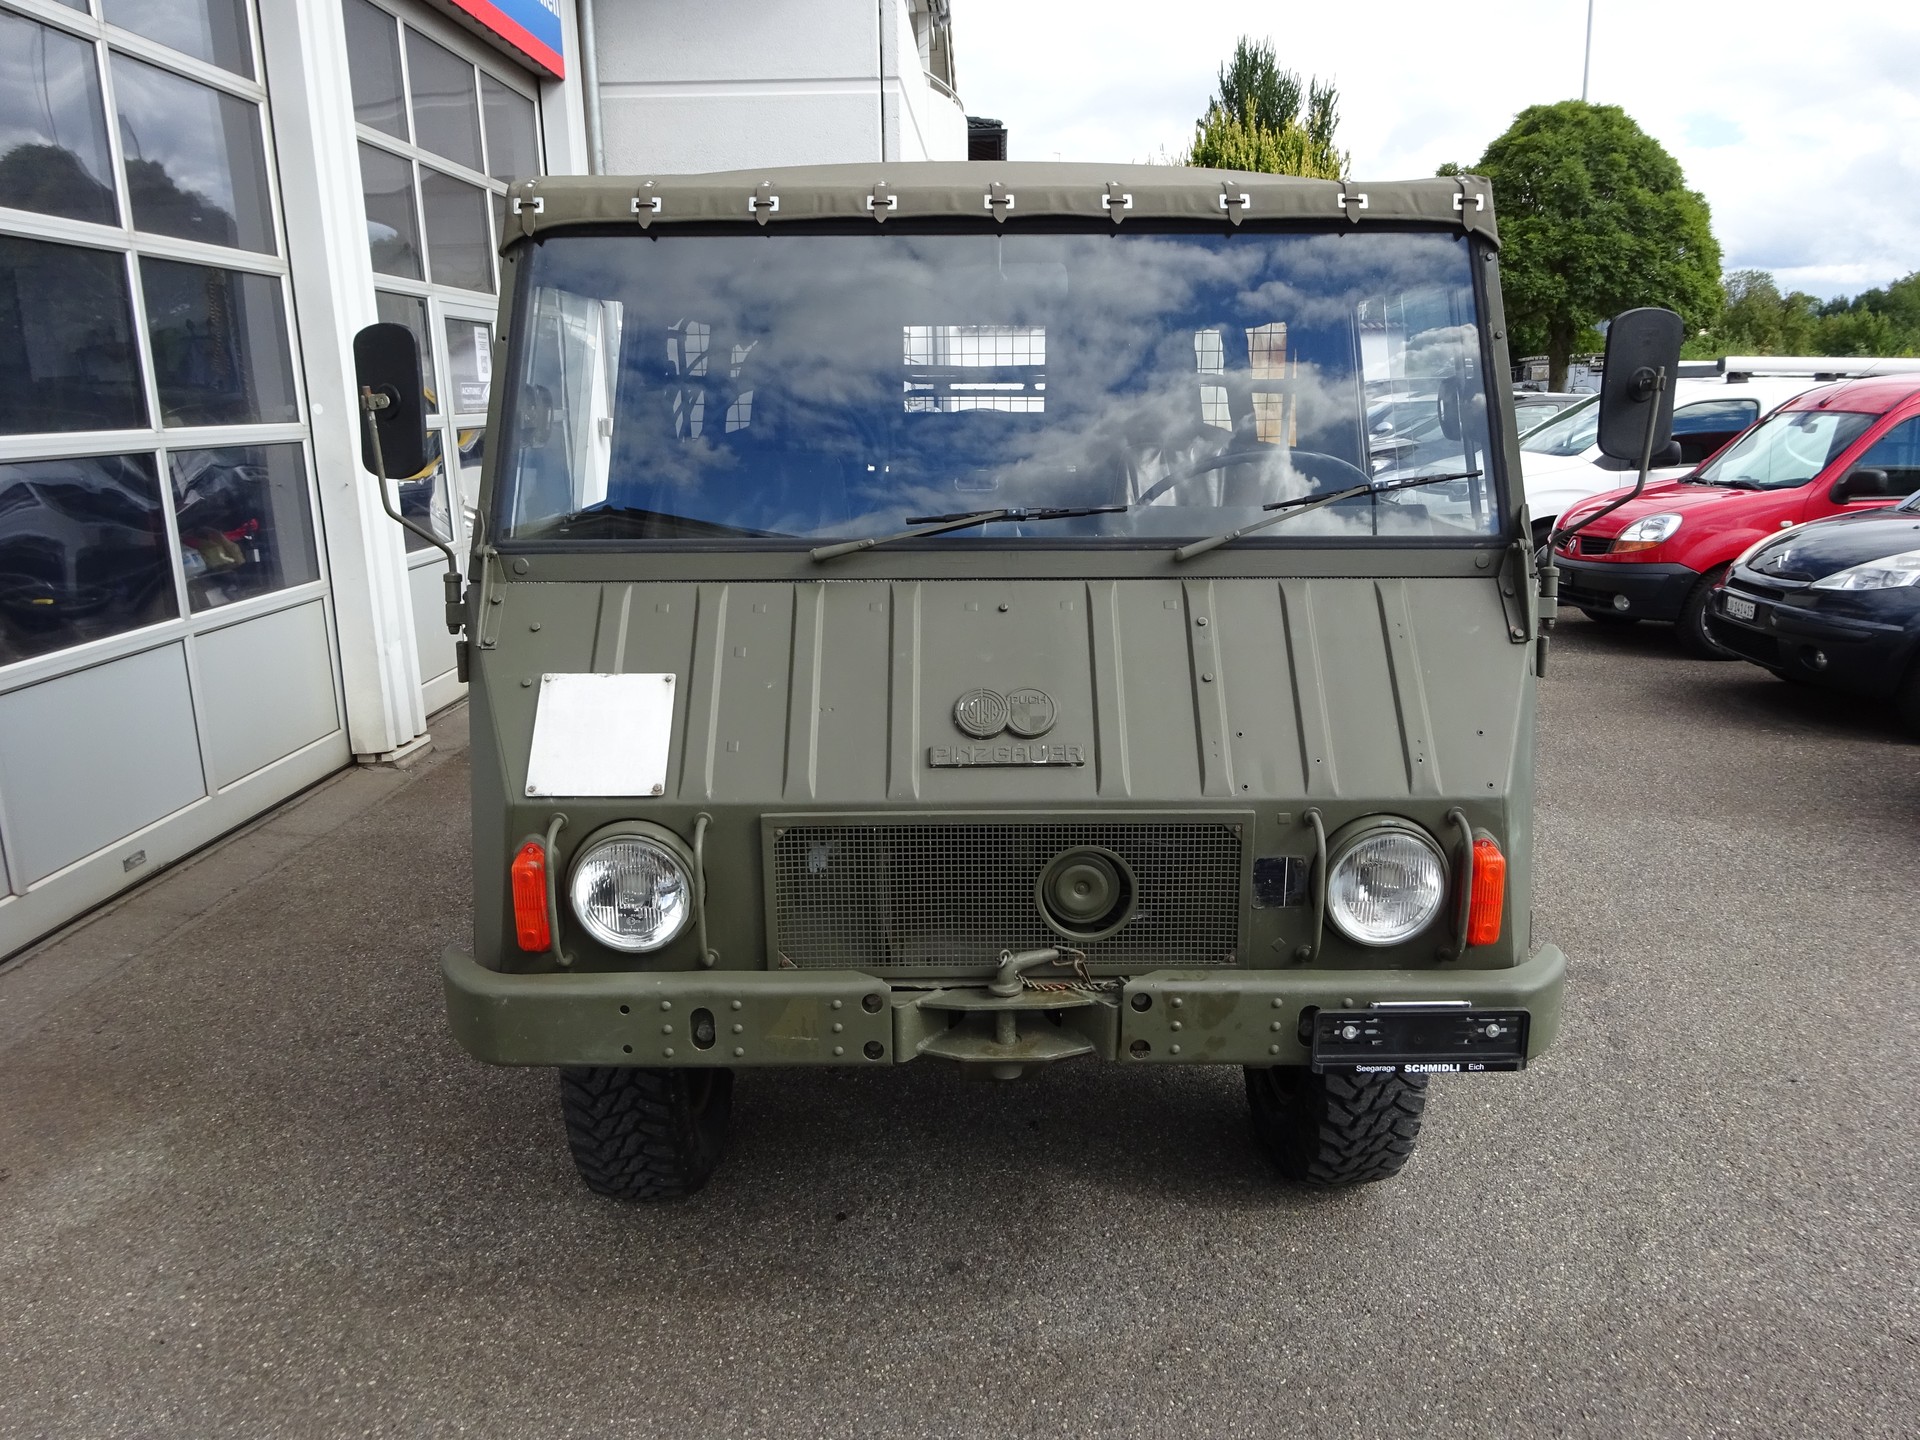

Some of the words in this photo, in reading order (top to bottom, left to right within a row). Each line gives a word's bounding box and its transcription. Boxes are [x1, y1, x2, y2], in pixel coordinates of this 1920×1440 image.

[1009, 695, 1047, 704] PUCH
[931, 745, 1083, 763] PINZGAUER
[1356, 1064, 1396, 1073] Seegarage
[1404, 1063, 1460, 1073] SCHMIDLI
[1468, 1063, 1485, 1071] Eich
